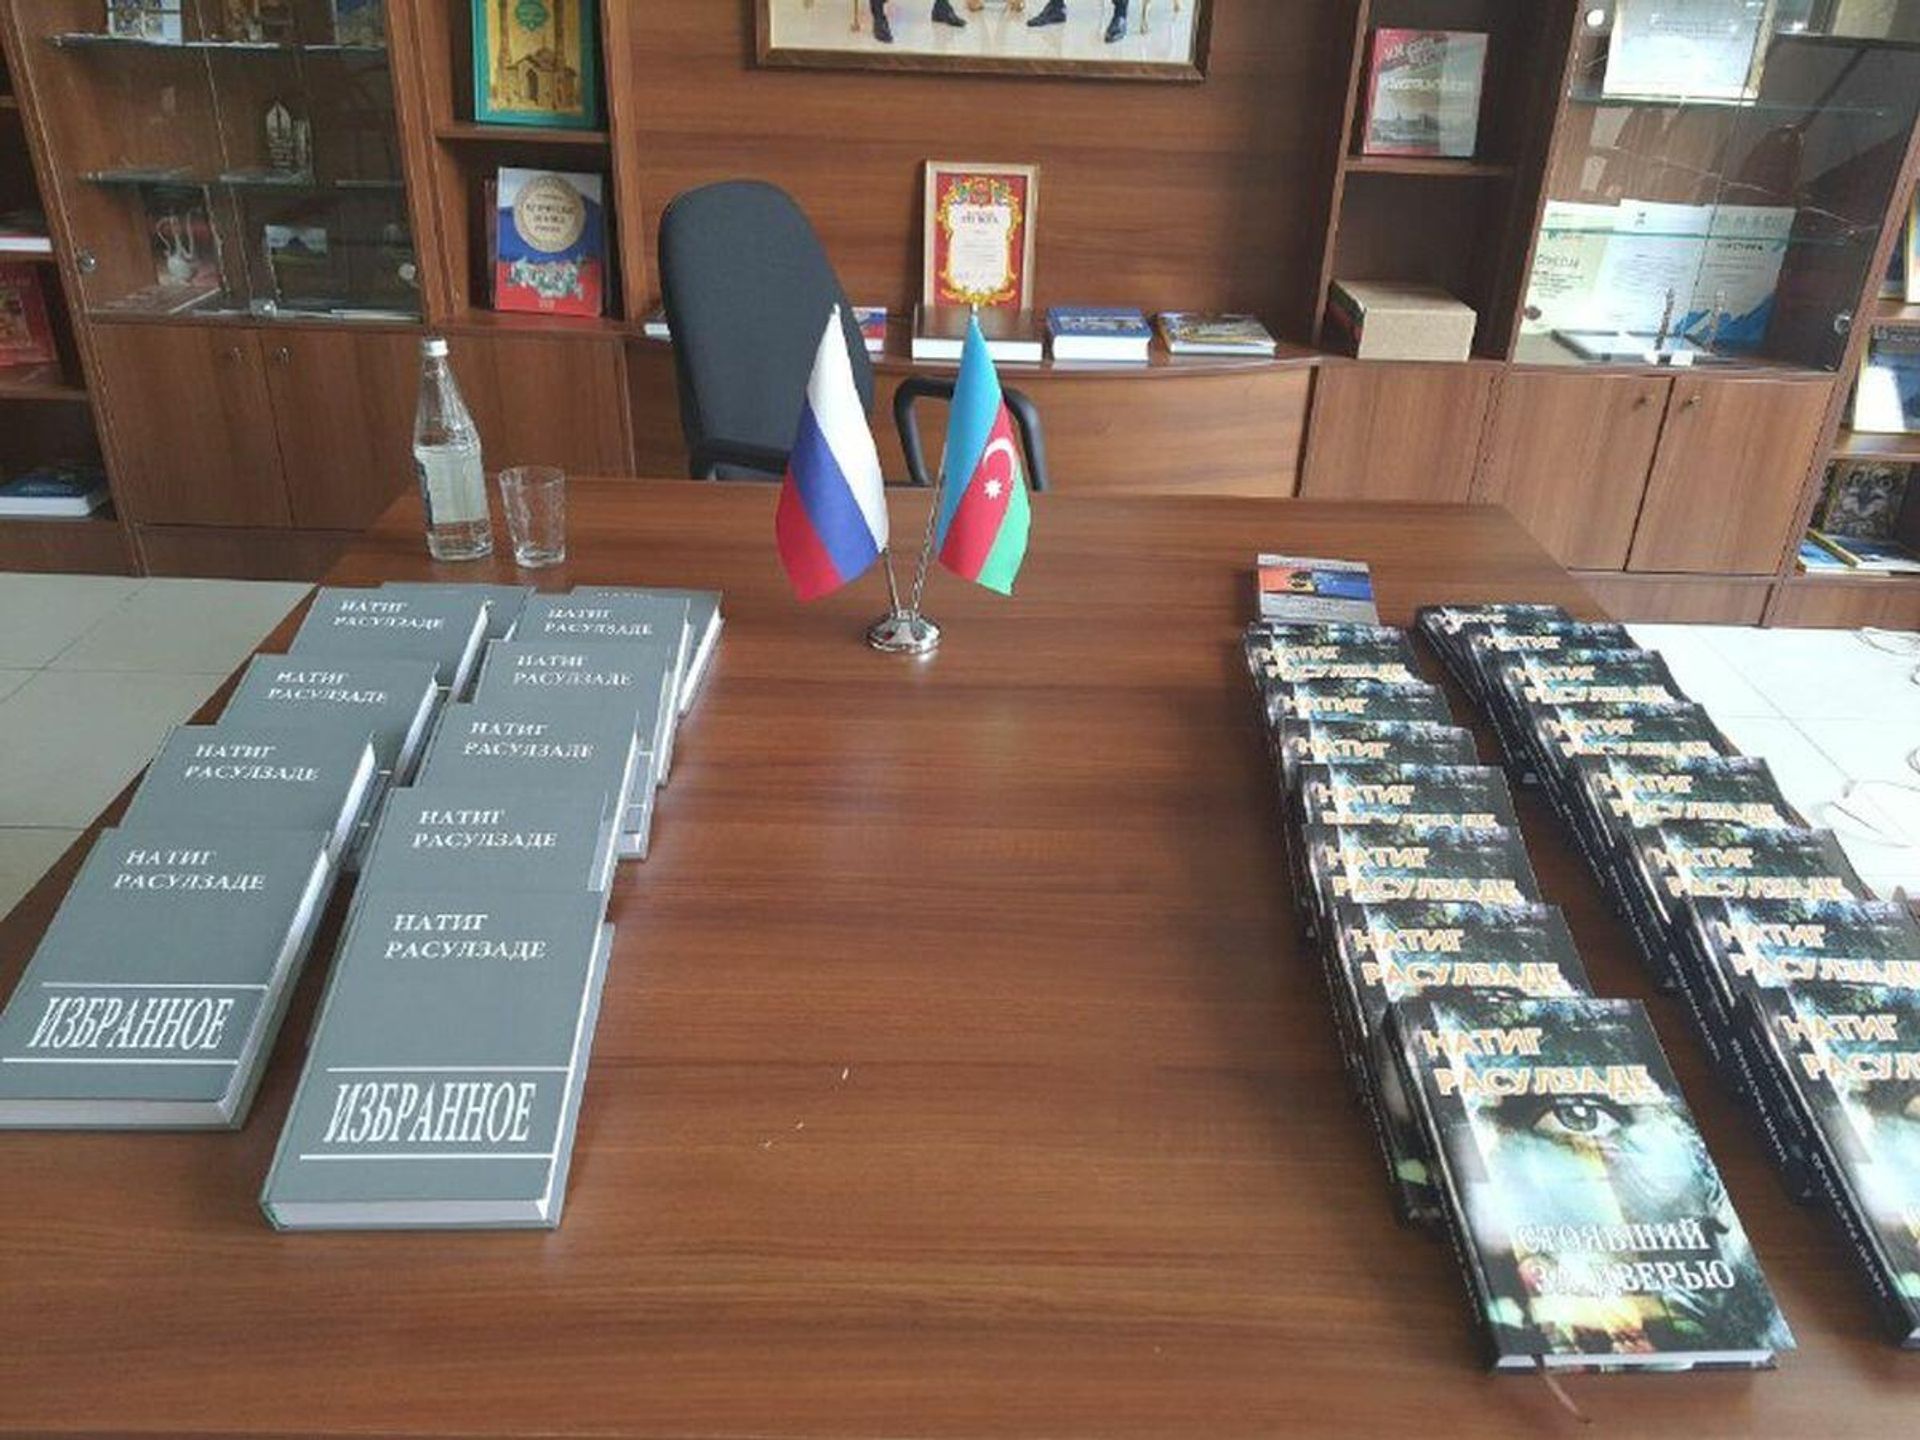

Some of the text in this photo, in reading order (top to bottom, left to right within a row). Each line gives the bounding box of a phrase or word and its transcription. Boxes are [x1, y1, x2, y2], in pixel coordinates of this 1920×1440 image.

[340, 600, 407, 613] НАТИГ
[547, 608, 613, 619] НАТИГ
[333, 616, 446, 630] РАСУЛЗАДЕ
[543, 623, 653, 636] РАСУЛЗАДЕ
[516, 654, 587, 667] НАТИГ
[275, 671, 349, 685] НАТИГ
[512, 672, 634, 686] РАСУЛЗАДЕ
[266, 688, 387, 703] РАСУЛЗАДЕ
[470, 721, 548, 735] НАТИГ
[194, 744, 277, 758] НАТИГ
[463, 741, 594, 758] РАСУЛЗАДЕ
[184, 764, 320, 781] РАСУЛЗАДЕ
[418, 809, 505, 825] НАТИГ
[412, 832, 558, 848] РАСУЛЗАДЕ
[125, 849, 217, 865] НАТИГ
[1324, 847, 1430, 869] НАТИГ
[1650, 847, 1753, 868] НАТИГ
[113, 873, 266, 891] РАСУЛЗАДЕ
[1330, 874, 1520, 903] РАСУЛЗАДЕ
[393, 913, 489, 931] НАТИГ
[1349, 927, 1465, 953] НАТИГ
[1715, 922, 1826, 948] НАТИГ
[383, 940, 547, 960] РАСУЛЗАДЕ
[1361, 961, 1563, 994] РАСУЛЗАДЕ
[27, 996, 235, 1050] ИЗБРАННОЕ
[1778, 1014, 1899, 1041] НАТИГ
[1420, 1026, 1544, 1057] НАТИГ
[1432, 1063, 1656, 1101] РАСУЛЗАДЕ
[322, 1081, 537, 1144] ИЗБРАННОЕ
